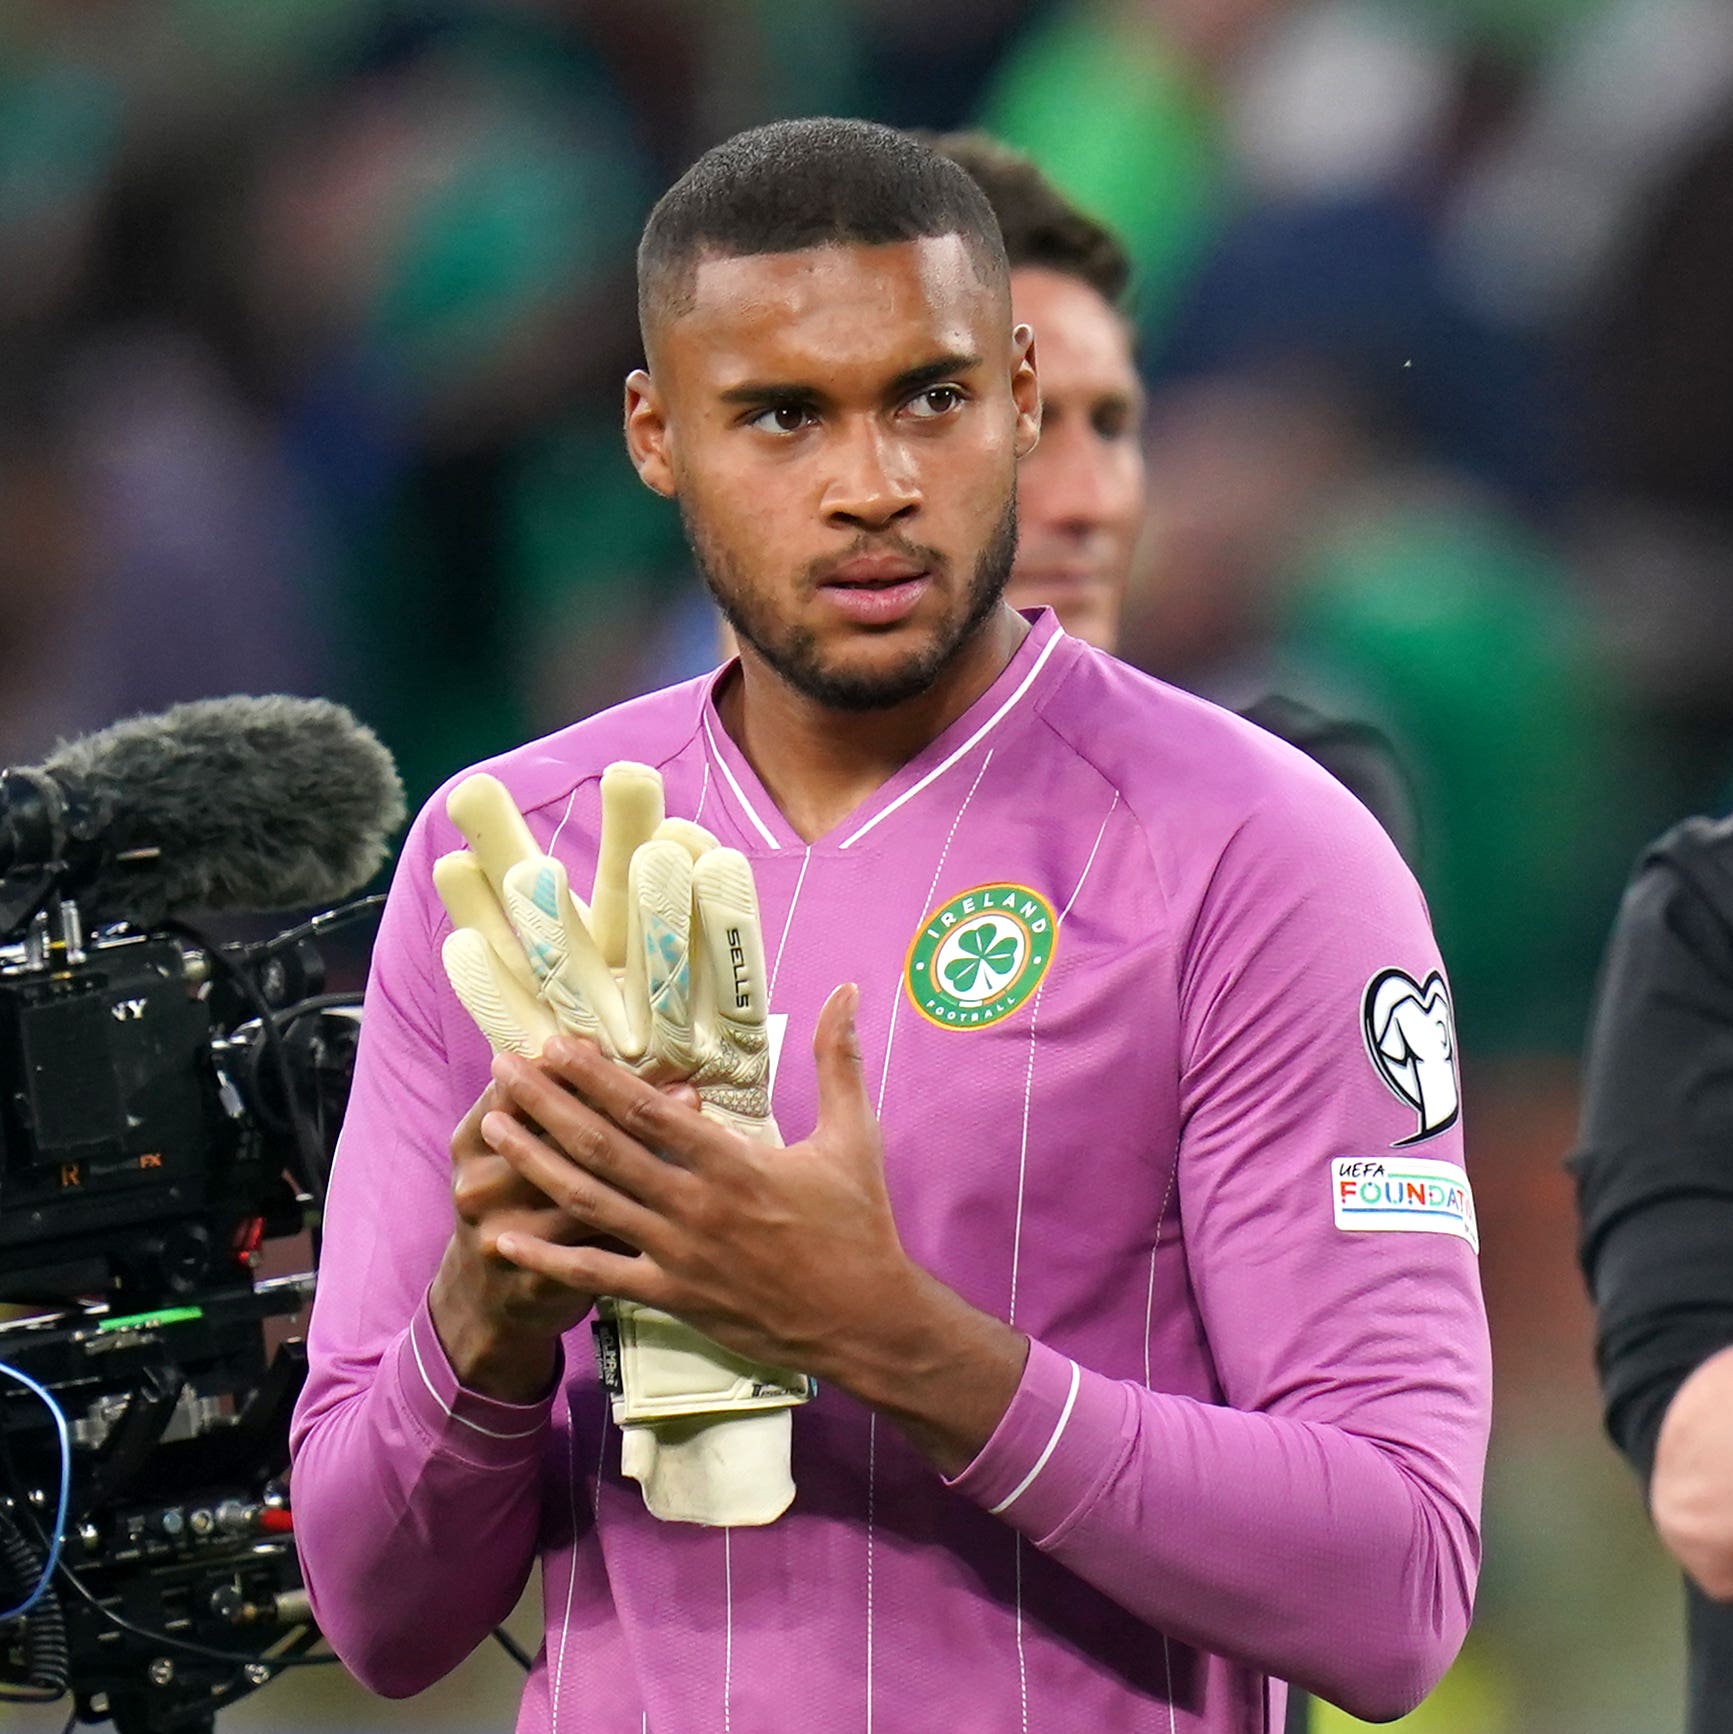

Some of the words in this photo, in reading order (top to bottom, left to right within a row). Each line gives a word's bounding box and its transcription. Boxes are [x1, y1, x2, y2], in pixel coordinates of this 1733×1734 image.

[927, 892, 1047, 939] IRELAND
[726, 928, 749, 1008] SELLS
[926, 999, 1015, 1022] FOOTBALL
[1339, 1162, 1385, 1177] UEFA
[1340, 1181, 1476, 1222] FOUNDAT
